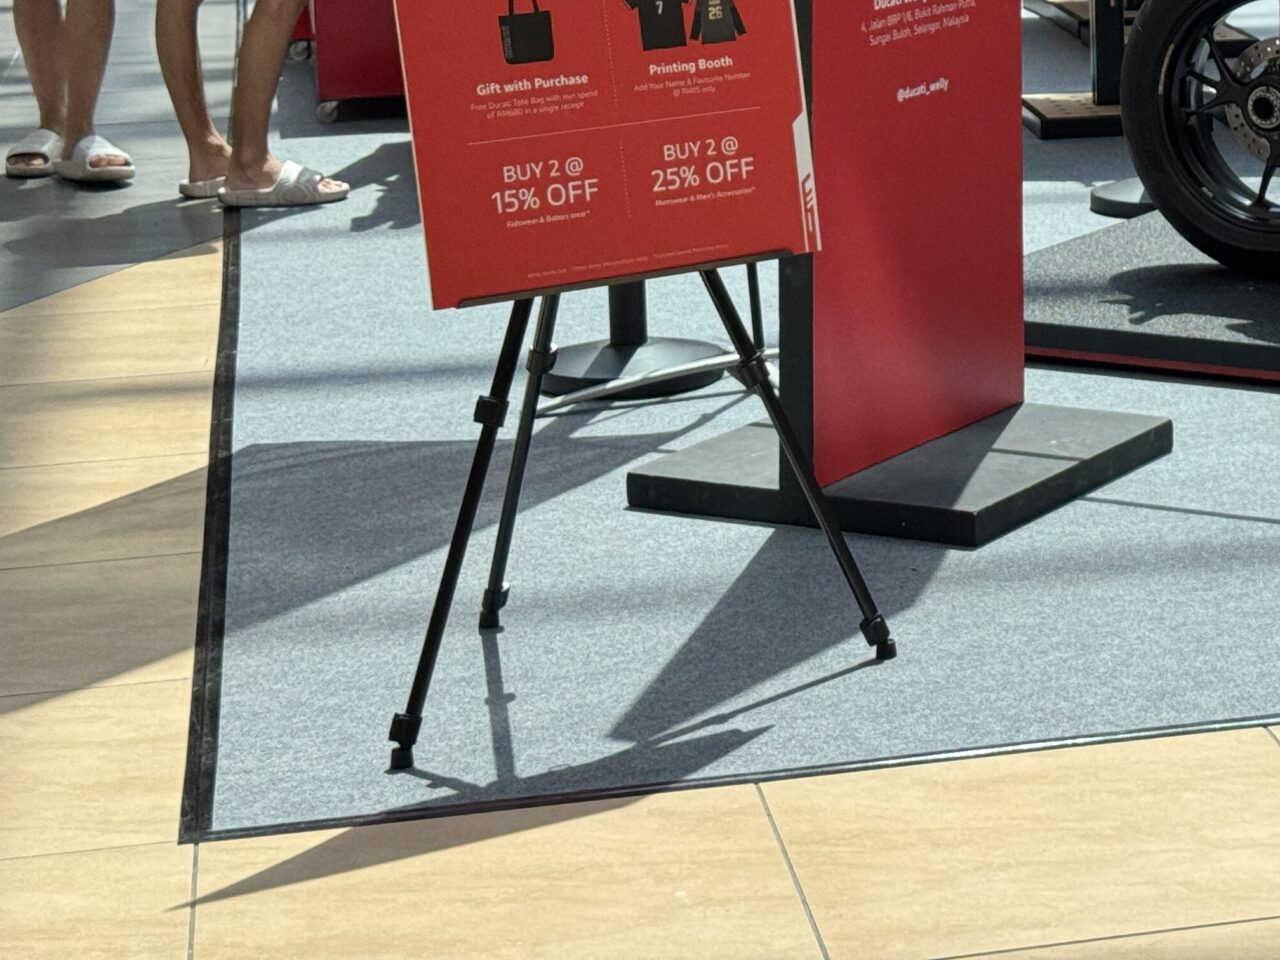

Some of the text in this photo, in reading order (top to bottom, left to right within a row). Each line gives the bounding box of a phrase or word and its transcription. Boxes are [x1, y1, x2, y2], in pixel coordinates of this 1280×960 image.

[655, 1, 664, 14] 7
[708, 6, 723, 20] 26
[649, 56, 733, 75] Printing Booth
[476, 74, 589, 96] Gift with Purchase
[663, 136, 739, 161] BUY 2 @
[502, 156, 584, 183] BUY 2 @
[650, 157, 755, 193] 25% OFF
[491, 178, 599, 214] 15% OFF
